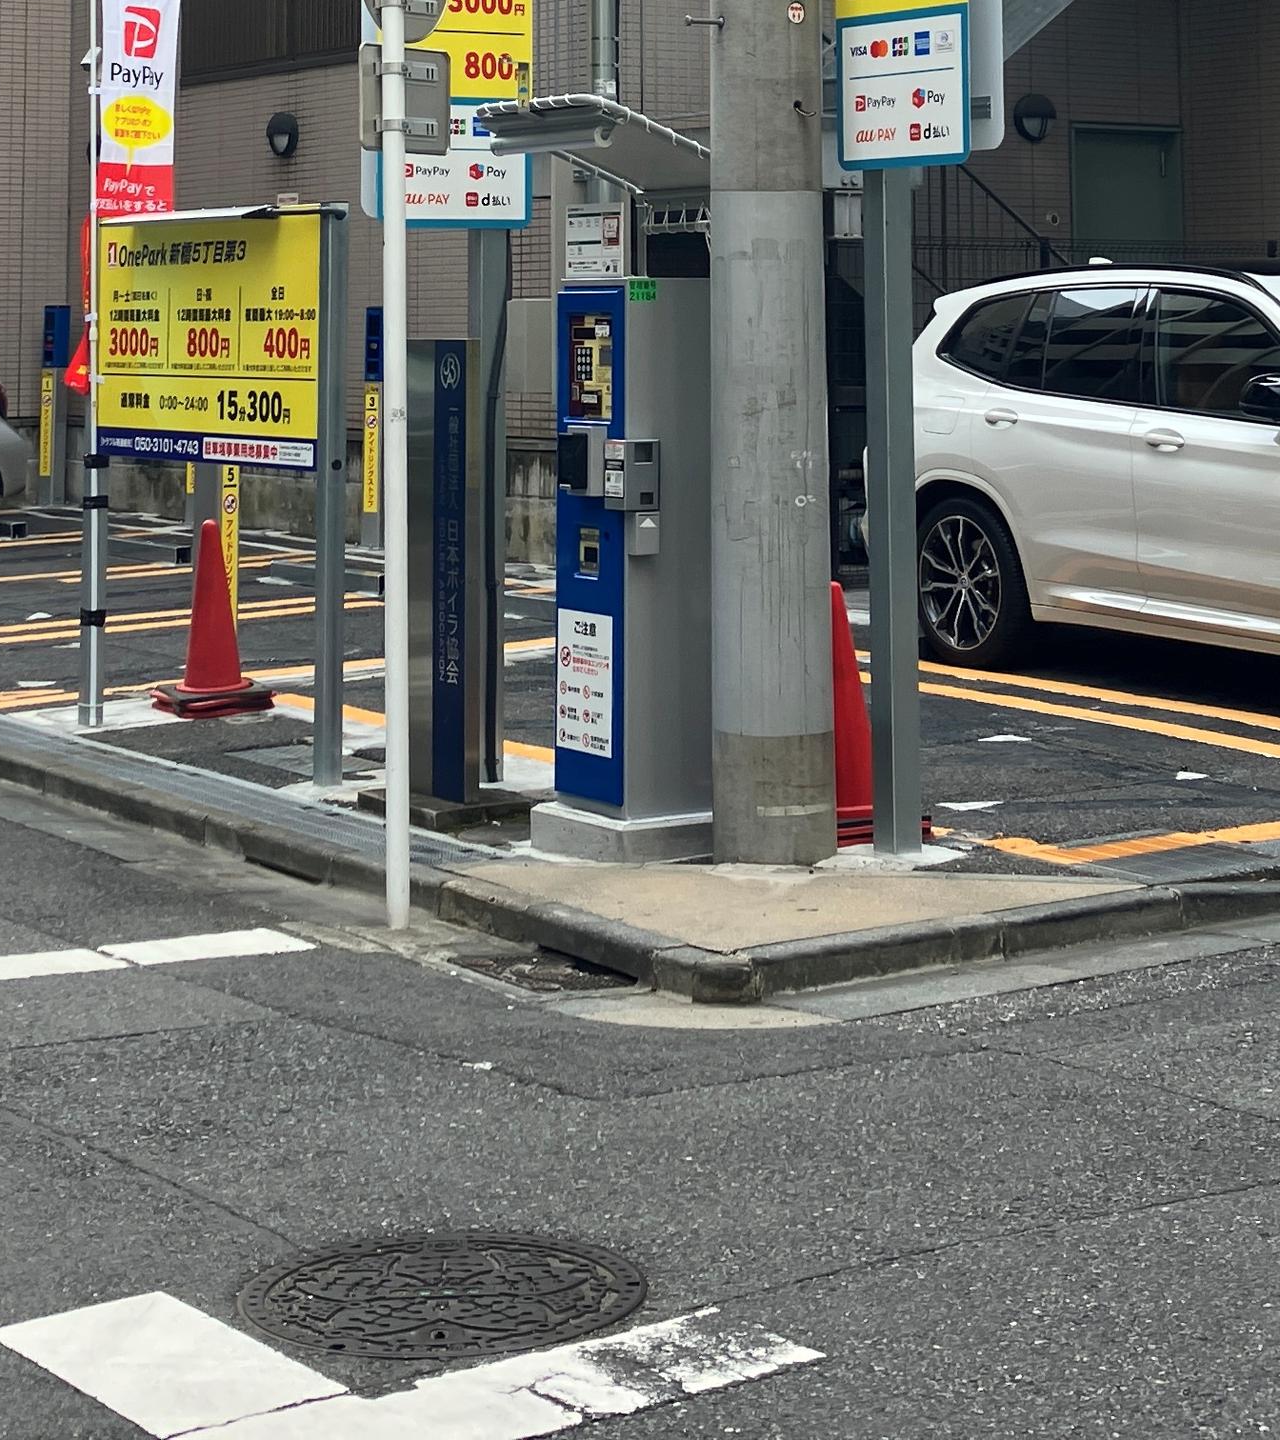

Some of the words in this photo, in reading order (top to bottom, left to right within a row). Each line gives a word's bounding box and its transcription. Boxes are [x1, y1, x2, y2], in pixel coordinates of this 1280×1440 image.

[850, 45, 867, 58] VISA
[465, 52, 519, 80] 800
[111, 62, 164, 90] PayPay
[867, 96, 896, 109] PayPay
[927, 90, 945, 105] Pay
[856, 129, 876, 143] au
[877, 127, 896, 141] PAY
[416, 166, 450, 177] PayPay
[486, 166, 507, 178] Pay
[428, 193, 450, 204] PAY
[119, 242, 167, 267] OnePark
[271, 286, 285, 301] 全日
[109, 327, 159, 357] 3000円
[187, 327, 230, 358] 800円
[263, 327, 310, 359] 400円
[120, 392, 150, 409] 通常料金
[369, 396, 375, 408] 3
[134, 436, 199, 456] 050-3101-4743
[227, 467, 235, 483] 5
[574, 620, 597, 637] ご注意
